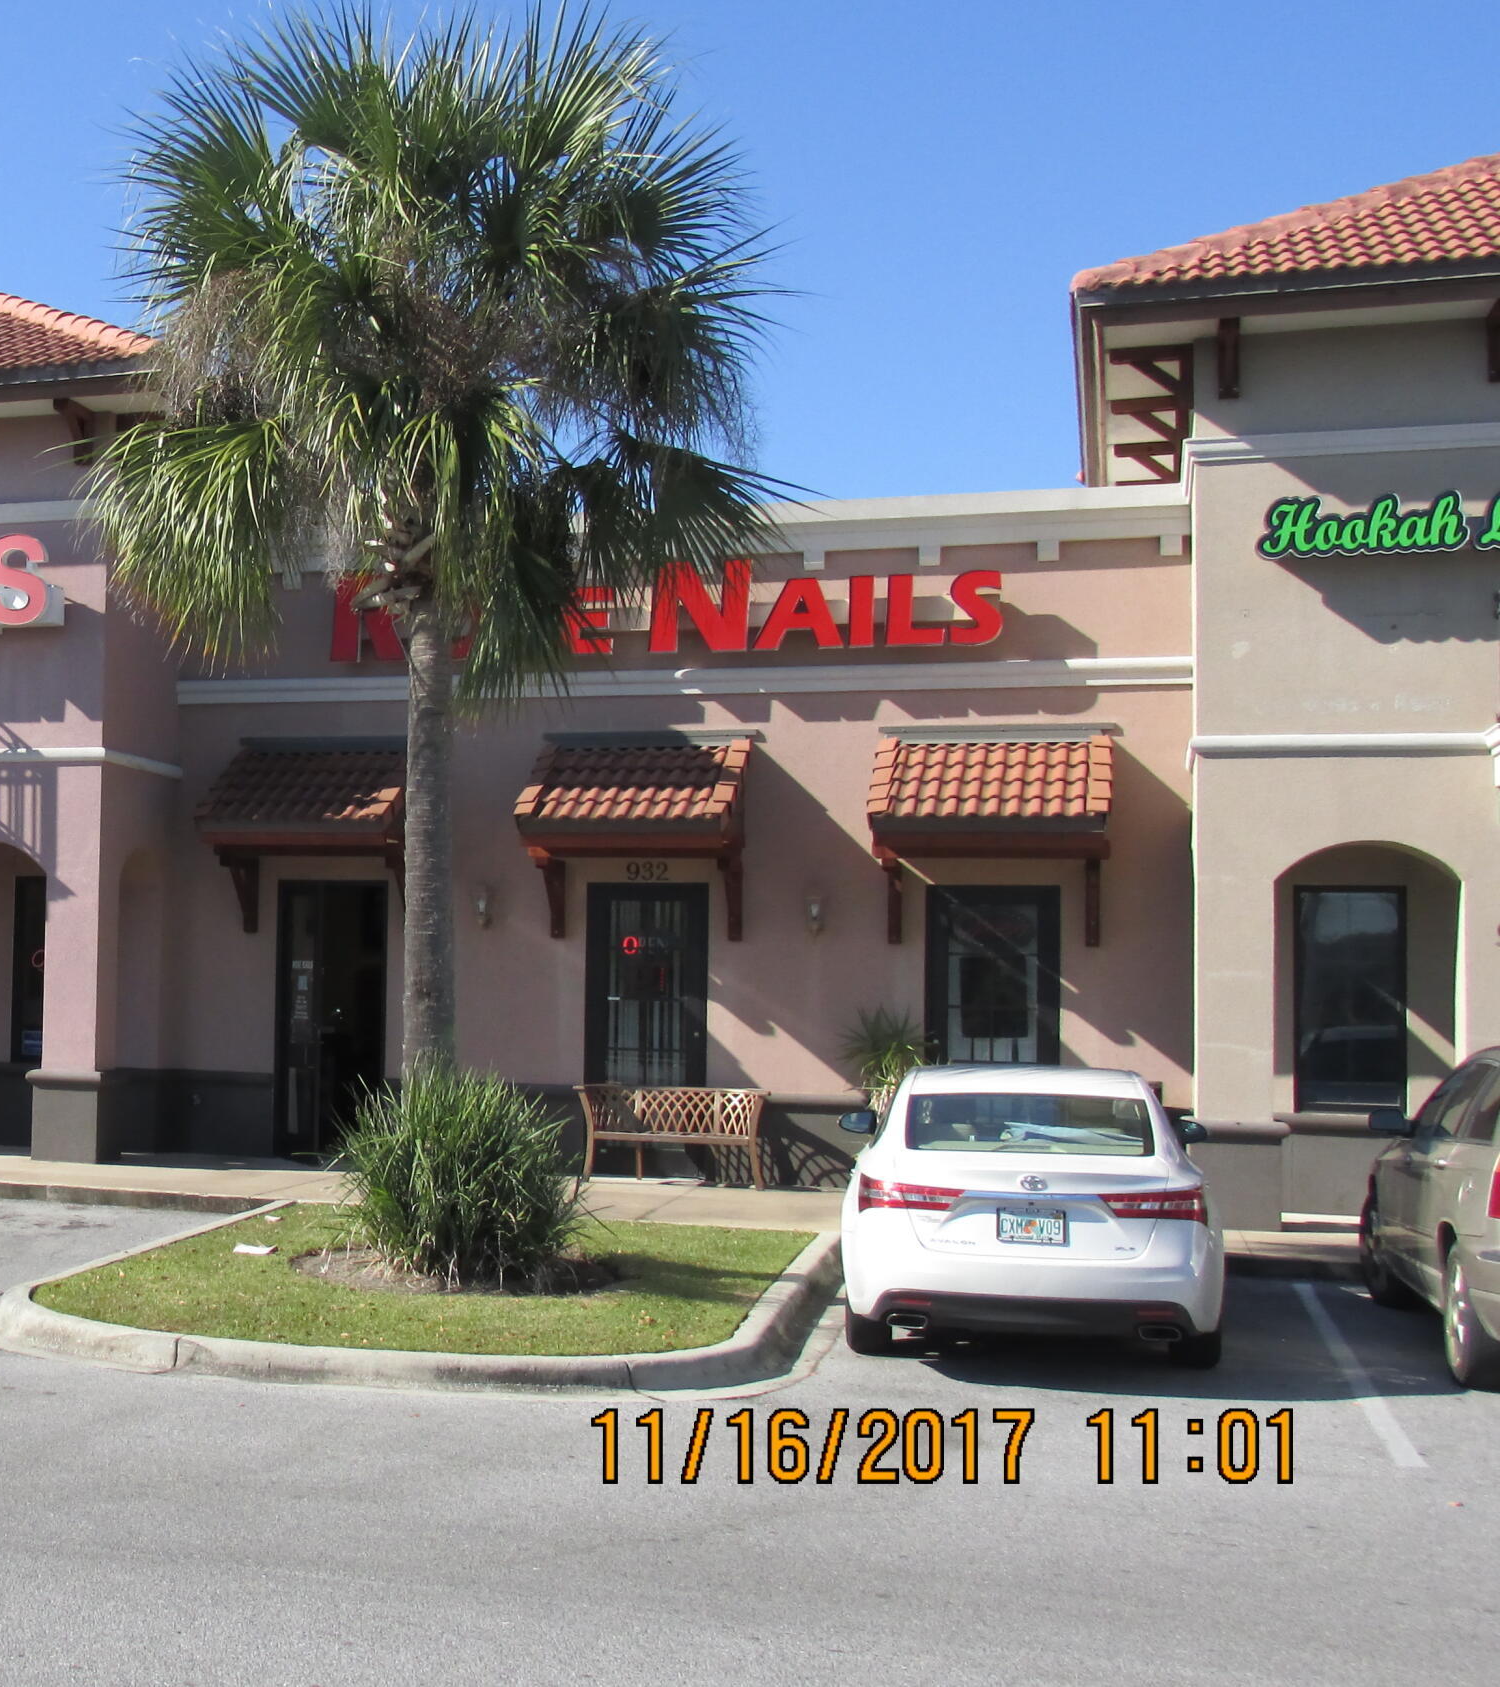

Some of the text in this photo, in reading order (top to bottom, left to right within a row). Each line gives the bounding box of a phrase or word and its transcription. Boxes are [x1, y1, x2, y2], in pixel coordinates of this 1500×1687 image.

[1261, 493, 1463, 554] Hookah
[329, 559, 1004, 662] RE NAILS
[626, 861, 669, 881] 932
